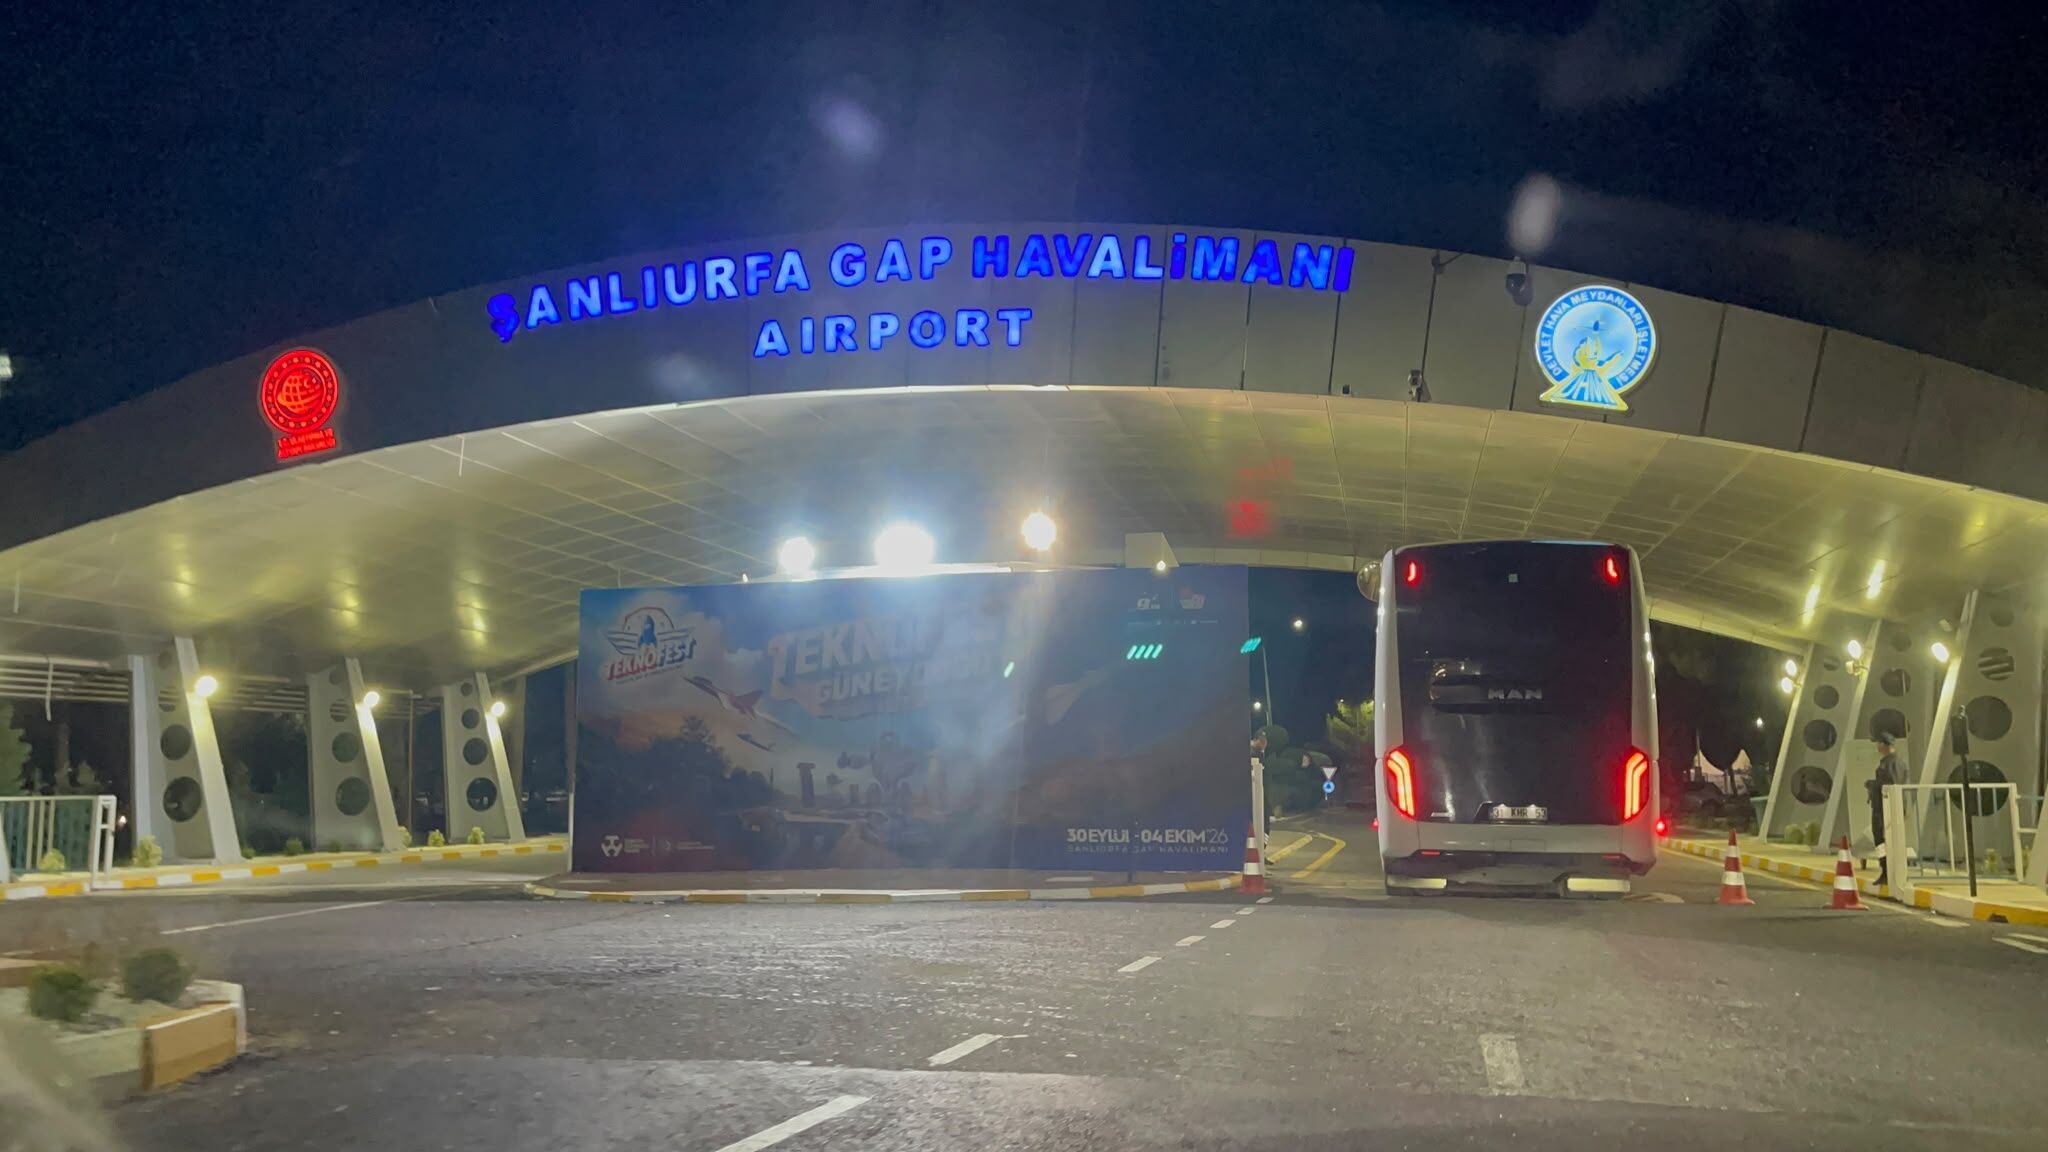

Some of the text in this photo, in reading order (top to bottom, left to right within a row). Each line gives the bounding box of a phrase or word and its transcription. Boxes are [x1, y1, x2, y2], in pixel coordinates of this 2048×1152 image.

[487, 249, 810, 343] ŞANLIURFA
[829, 236, 952, 287] GAP
[1546, 303, 1570, 330] HAVA
[1570, 291, 1644, 327] MEYDANLARI
[753, 308, 1032, 358] AIRPORT
[603, 637, 698, 681] TEKNOFEST
[1487, 687, 1543, 700] MAN
[1066, 828, 1087, 843] 30
[1141, 828, 1163, 843] 04
